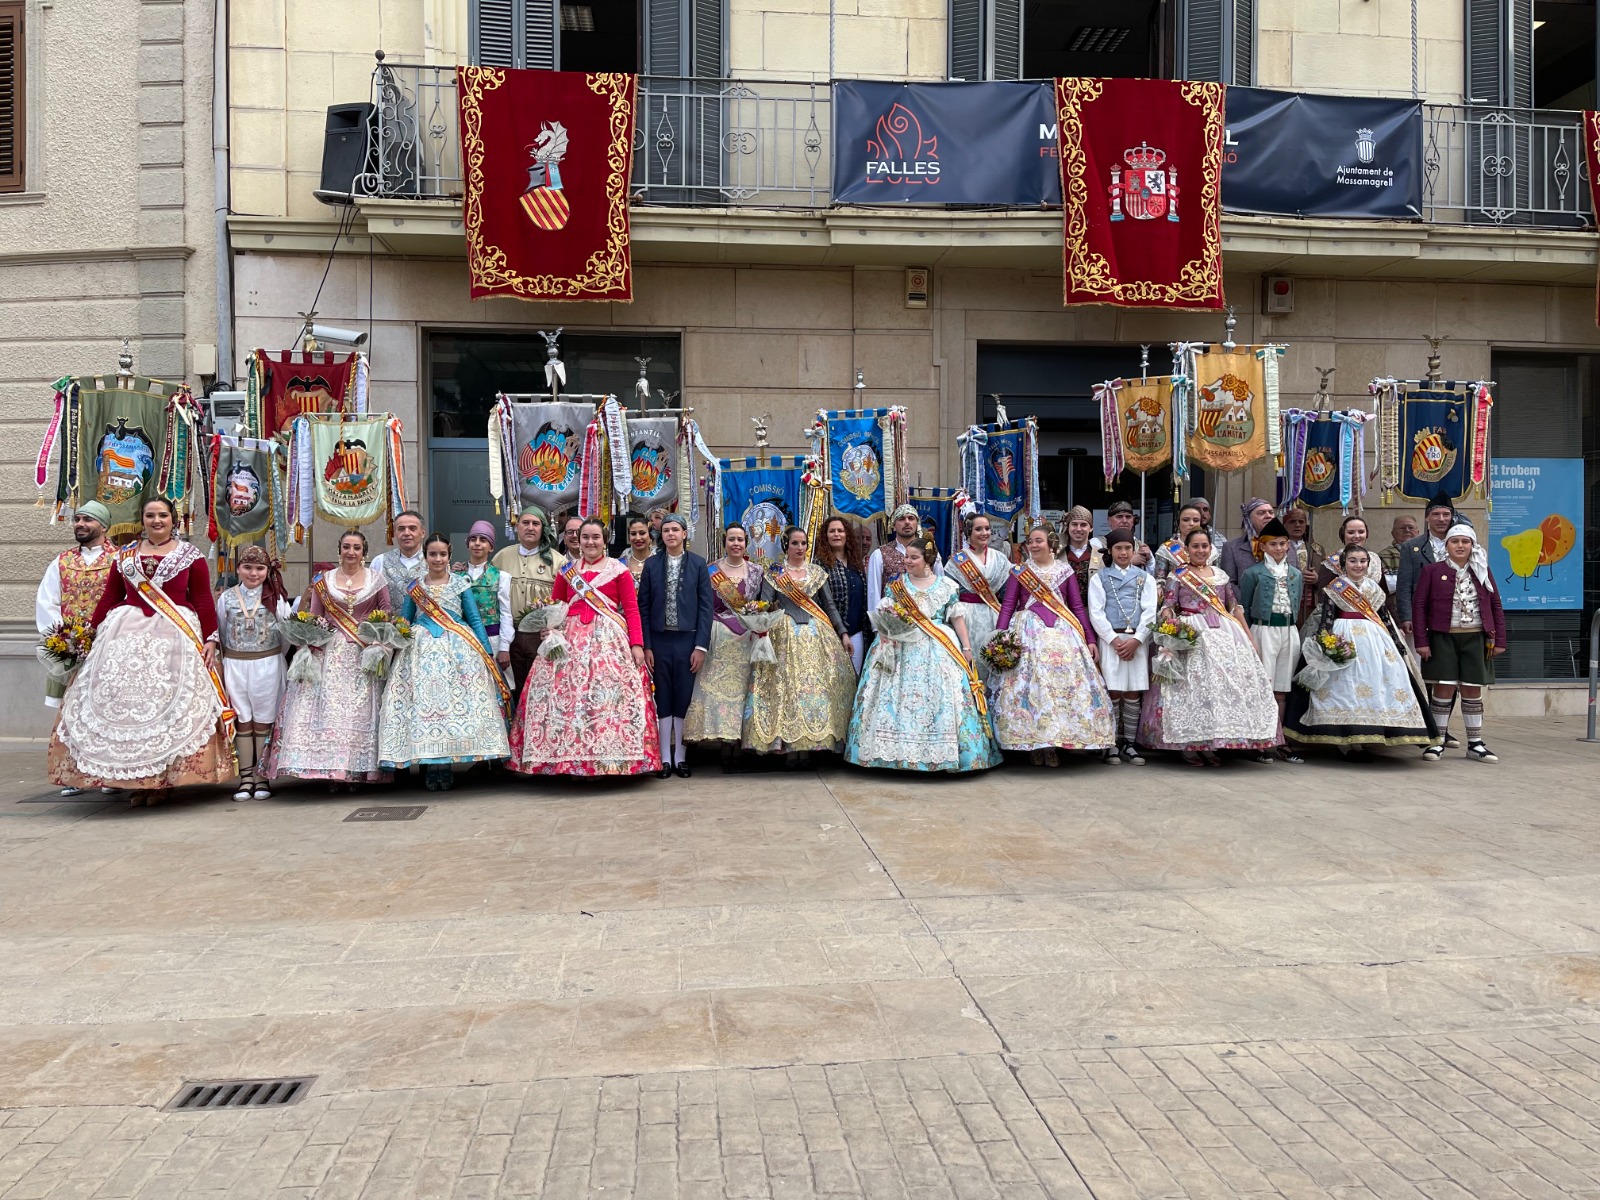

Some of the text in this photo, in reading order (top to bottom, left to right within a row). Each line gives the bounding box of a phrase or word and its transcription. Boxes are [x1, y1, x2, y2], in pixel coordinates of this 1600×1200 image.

[866, 161, 941, 175] FALLES
[1336, 165, 1394, 177] Ajuntament de
[1336, 175, 1393, 188] Massamagrell
[1501, 465, 1540, 476] trobem
[749, 483, 785, 496] COMISSIÓ
